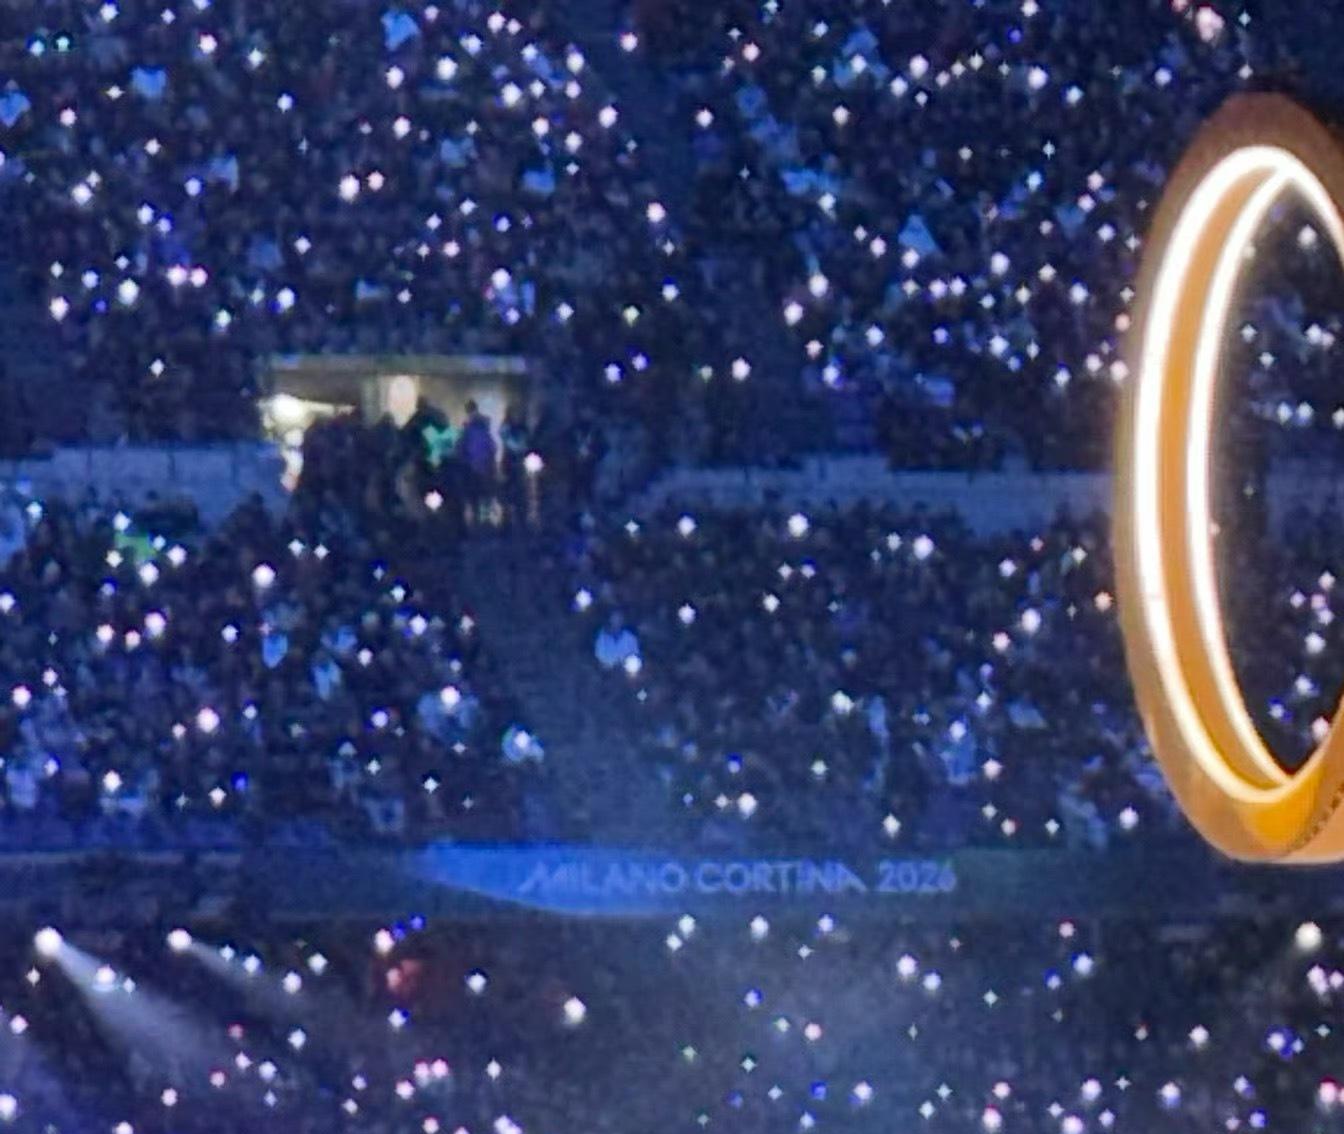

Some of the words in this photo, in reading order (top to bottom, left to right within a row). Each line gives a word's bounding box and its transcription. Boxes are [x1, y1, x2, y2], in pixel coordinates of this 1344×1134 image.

[518, 861, 688, 893] MILANO
[696, 861, 867, 893] CORTINA
[878, 860, 957, 892] 2026
